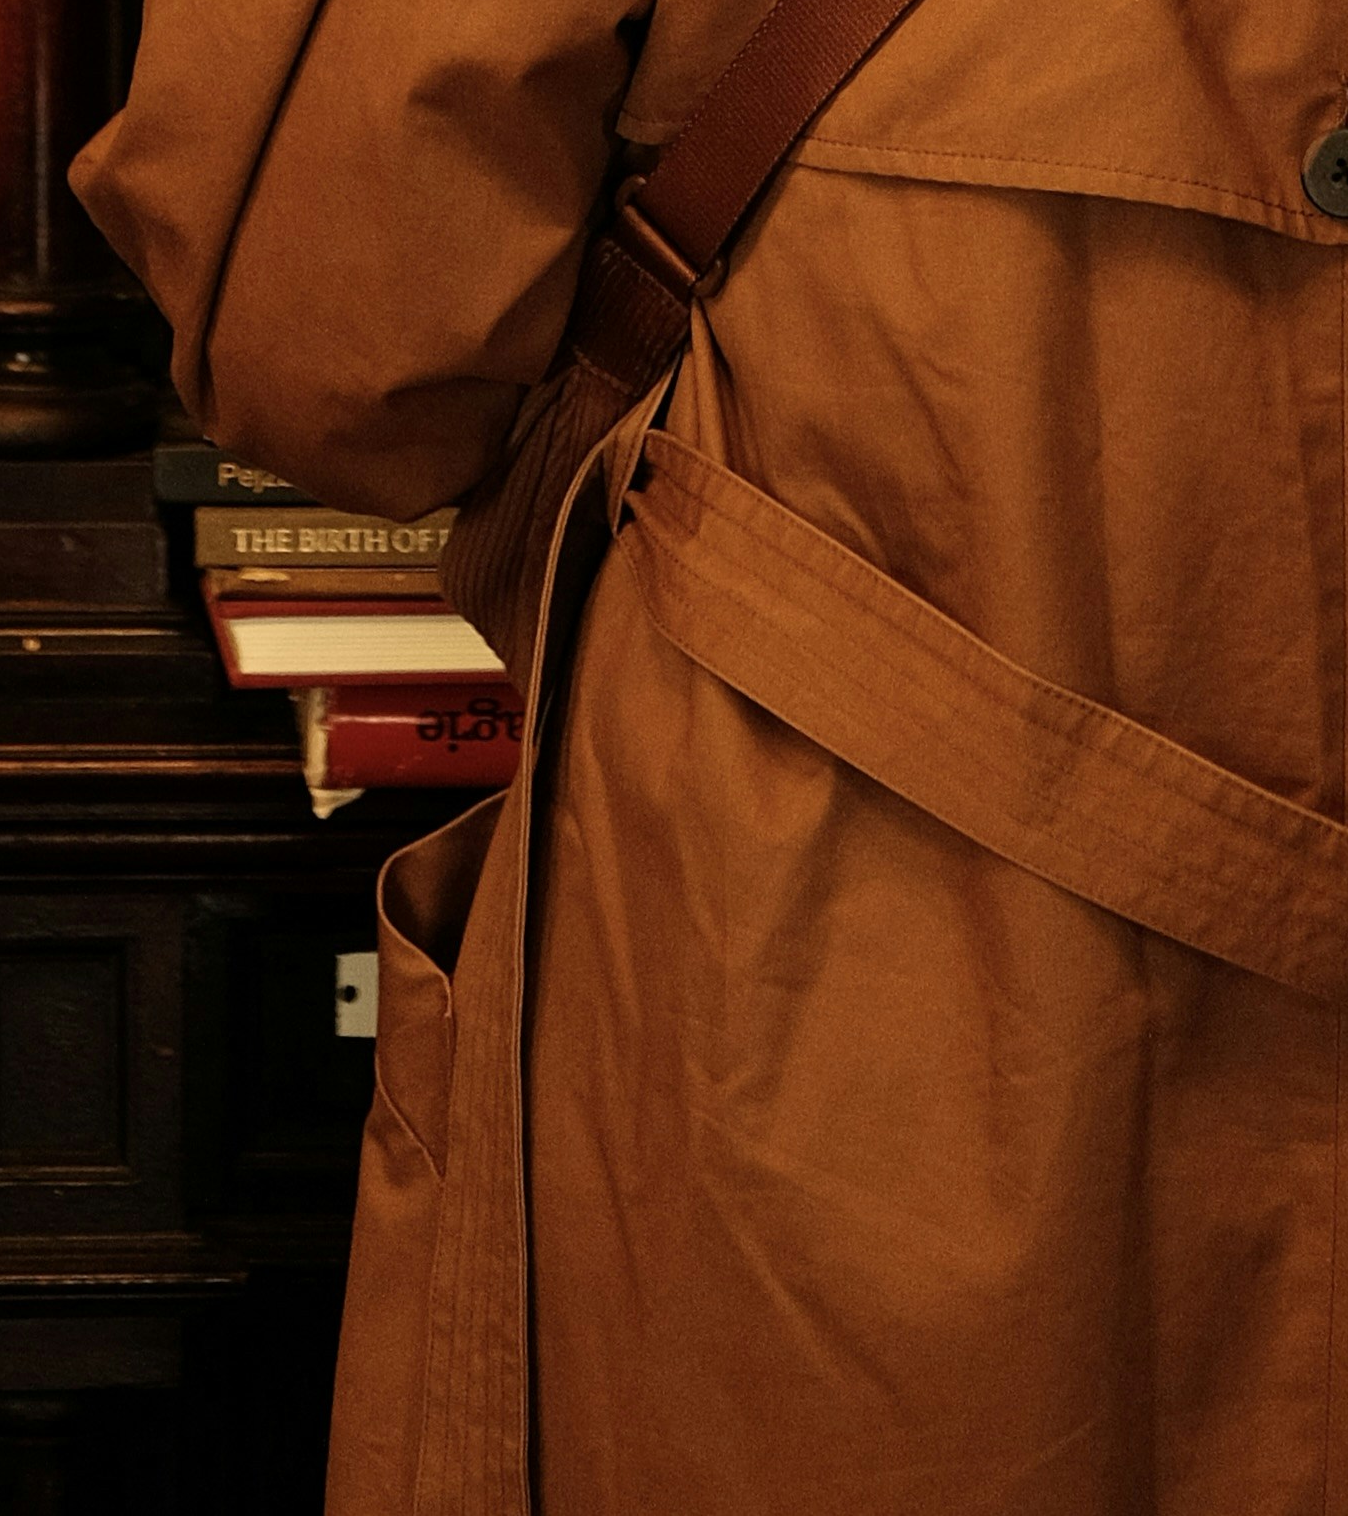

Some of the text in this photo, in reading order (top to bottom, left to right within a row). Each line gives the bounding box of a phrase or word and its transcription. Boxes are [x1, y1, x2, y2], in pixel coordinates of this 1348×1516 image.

[232, 528, 437, 553] THE BIRTH OF
